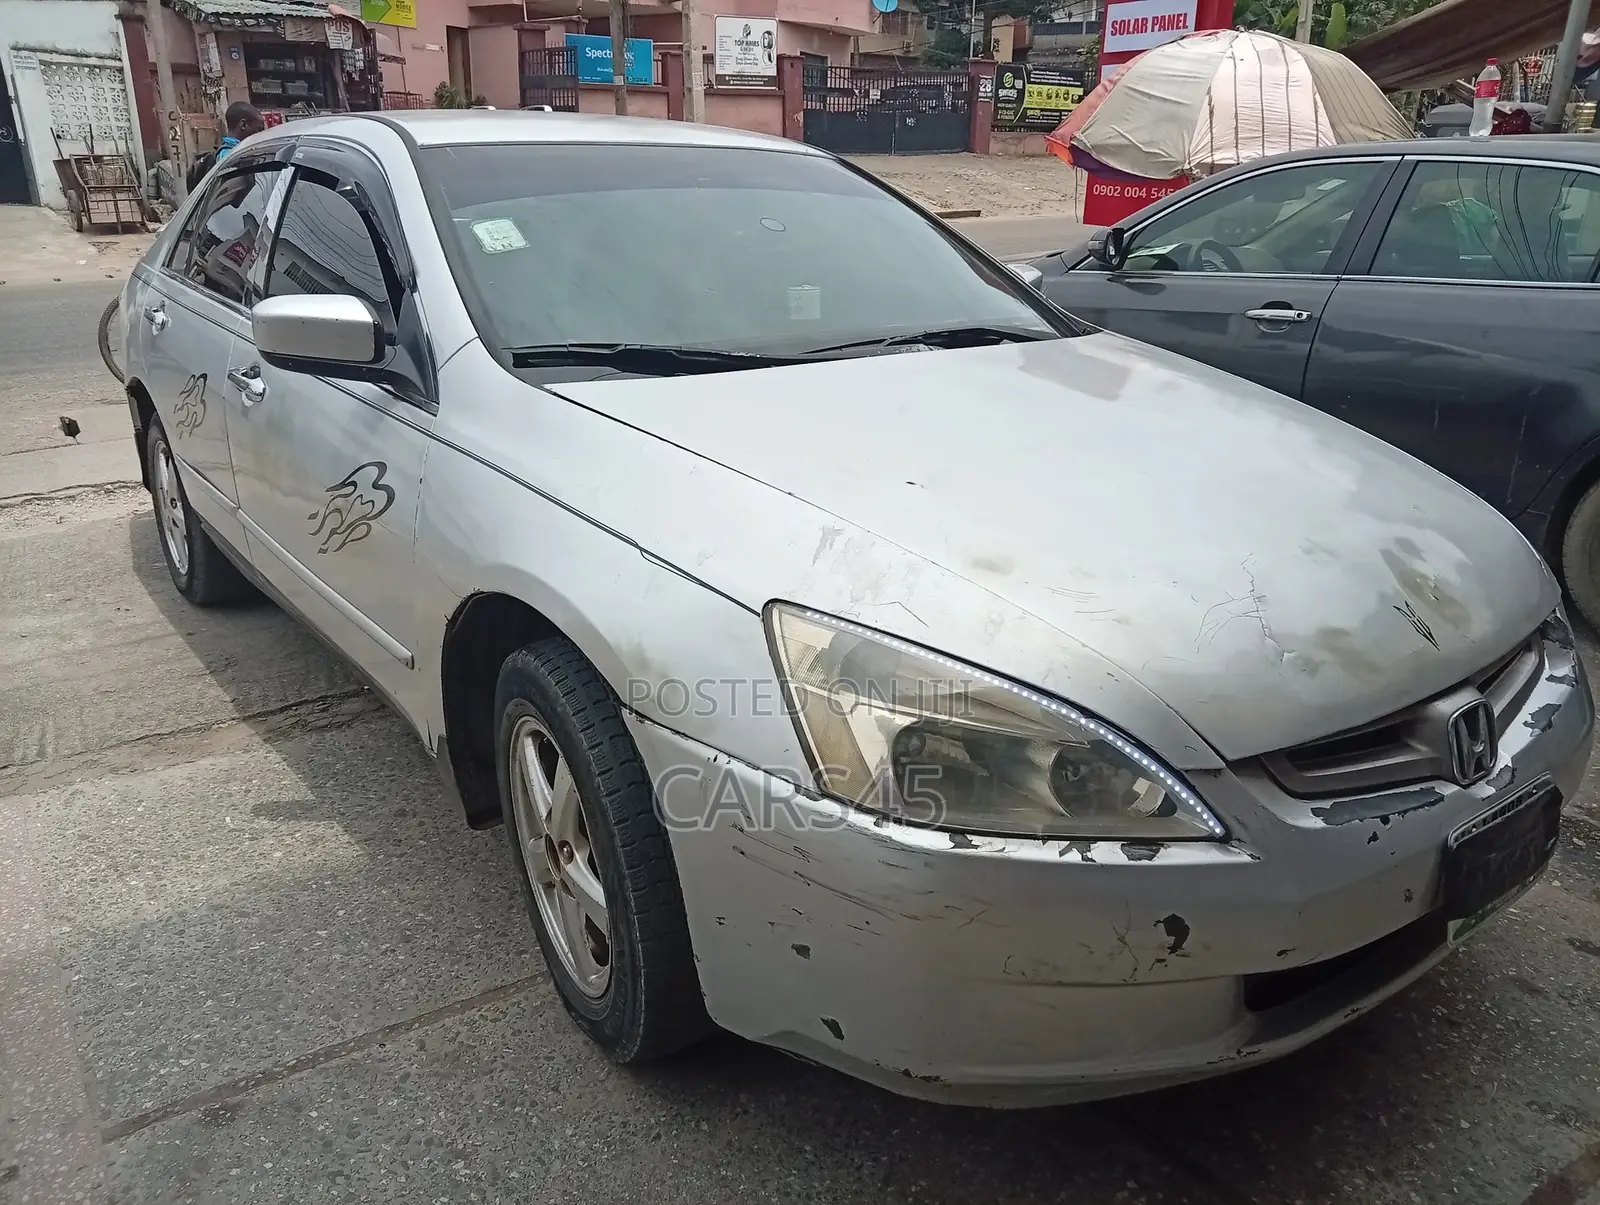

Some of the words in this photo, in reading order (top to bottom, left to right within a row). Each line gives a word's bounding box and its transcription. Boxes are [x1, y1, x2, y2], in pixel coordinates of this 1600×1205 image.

[327, 18, 350, 33] POS
[1110, 17, 1148, 36] SOLAR
[1151, 13, 1188, 32] PANEL
[980, 78, 992, 92] 28
[1092, 184, 1121, 197] 0902
[1124, 186, 1147, 198] 004
